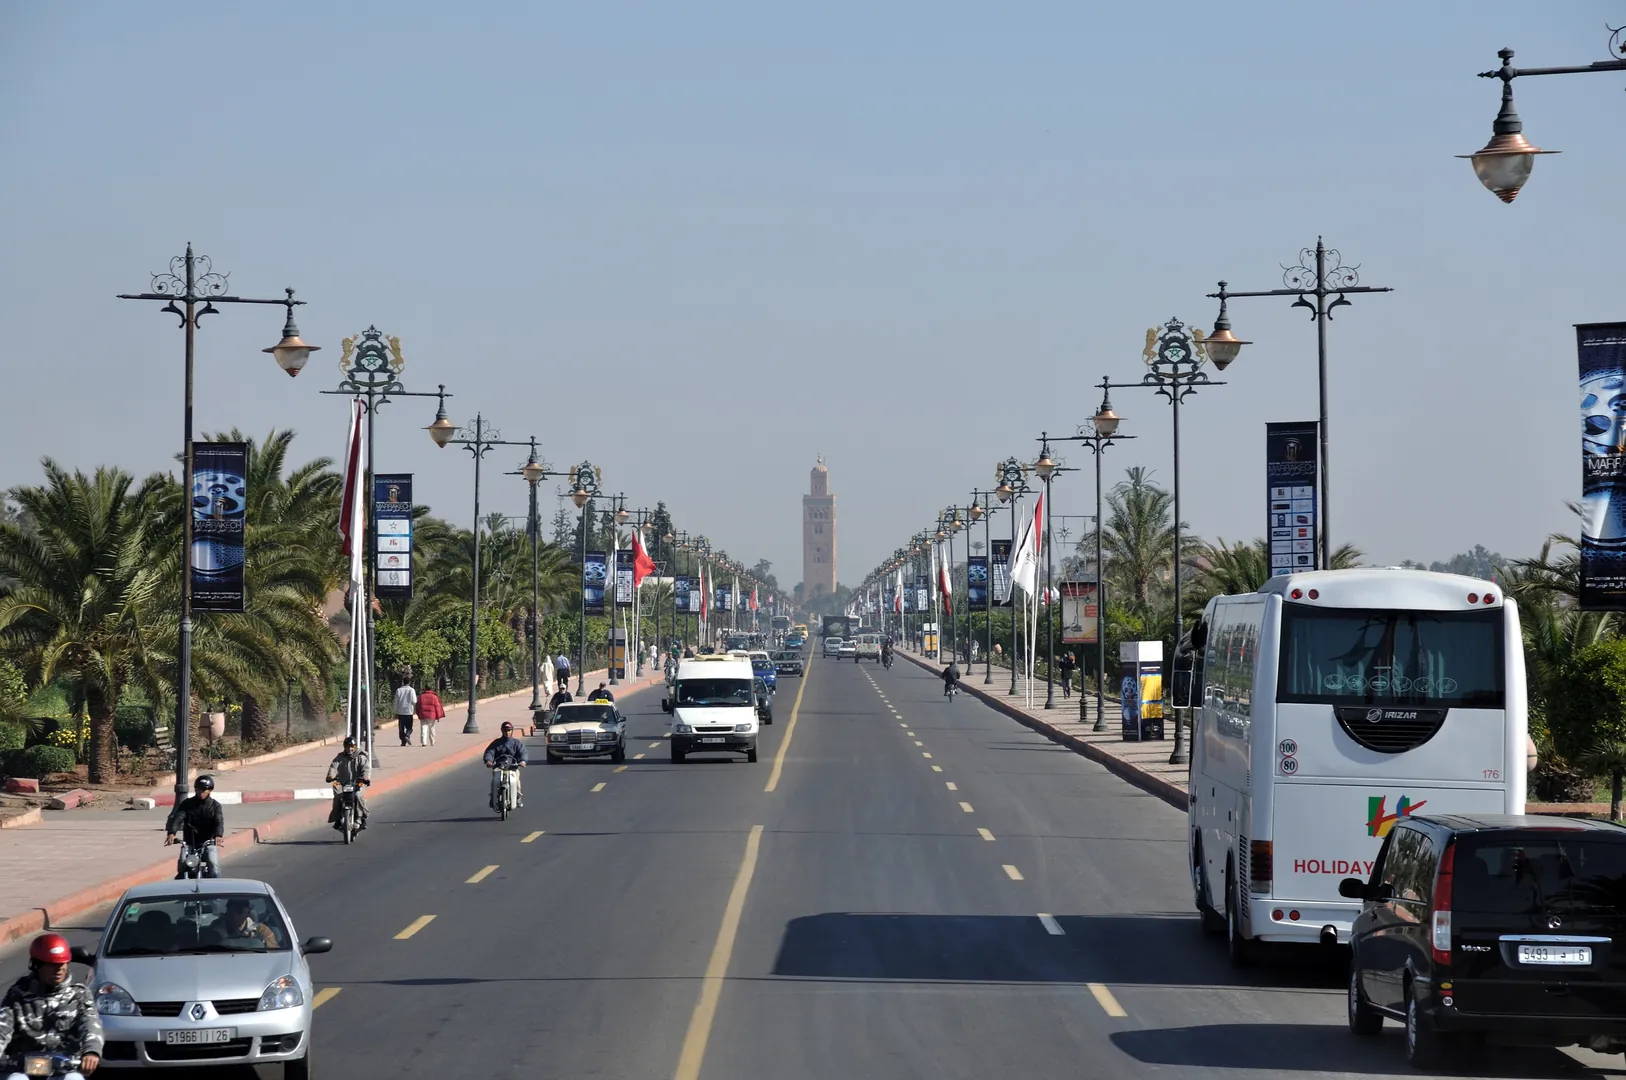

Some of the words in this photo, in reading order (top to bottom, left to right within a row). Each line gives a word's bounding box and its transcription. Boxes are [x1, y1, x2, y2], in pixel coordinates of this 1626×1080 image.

[194, 521, 242, 529] MARRAKECH
[1384, 711, 1417, 720] IRIZAR
[1282, 743, 1296, 753] 100
[1283, 761, 1295, 771] 80
[1482, 769, 1499, 779] 176
[1294, 859, 1374, 875] HOLIDAY
[1524, 948, 1548, 961] 5493
[1578, 949, 1585, 961] 6
[168, 1031, 197, 1043] 51966
[216, 1029, 228, 1041] 26
